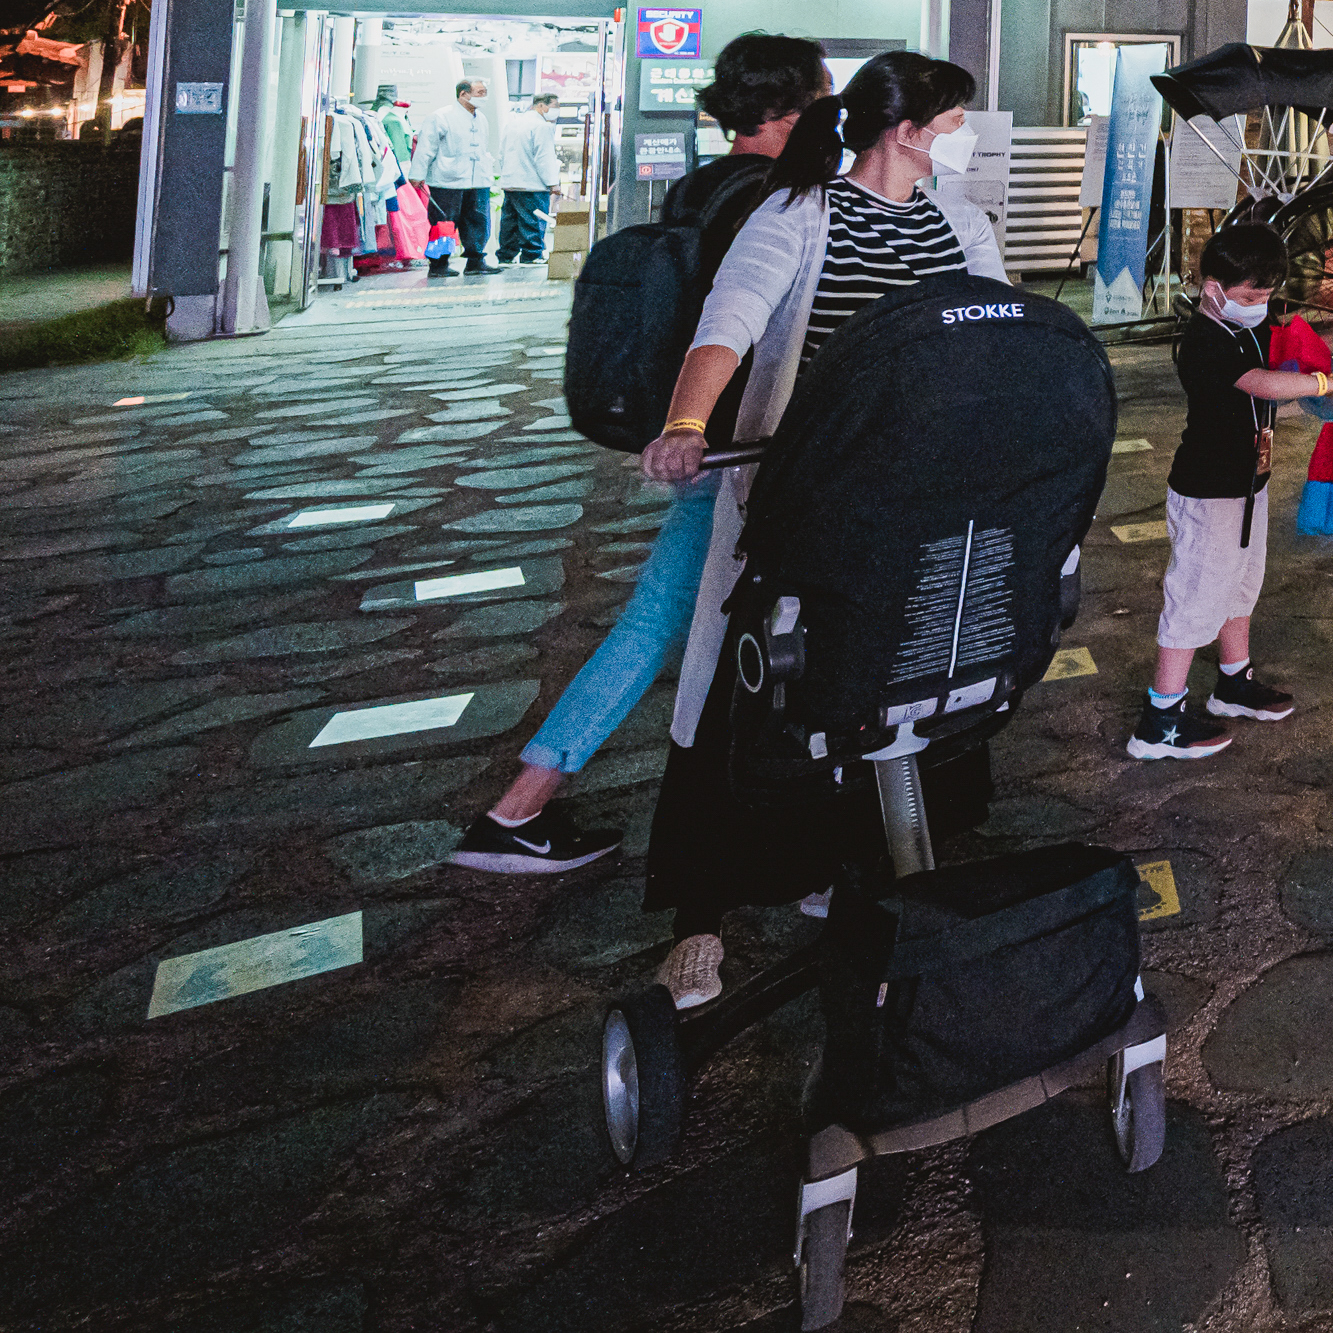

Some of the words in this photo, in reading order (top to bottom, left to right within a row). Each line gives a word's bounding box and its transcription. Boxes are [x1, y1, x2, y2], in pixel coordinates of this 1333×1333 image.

[645, 10, 694, 19] SECURITY
[650, 87, 696, 104] 계산
[941, 302, 1025, 325] STOKKE
